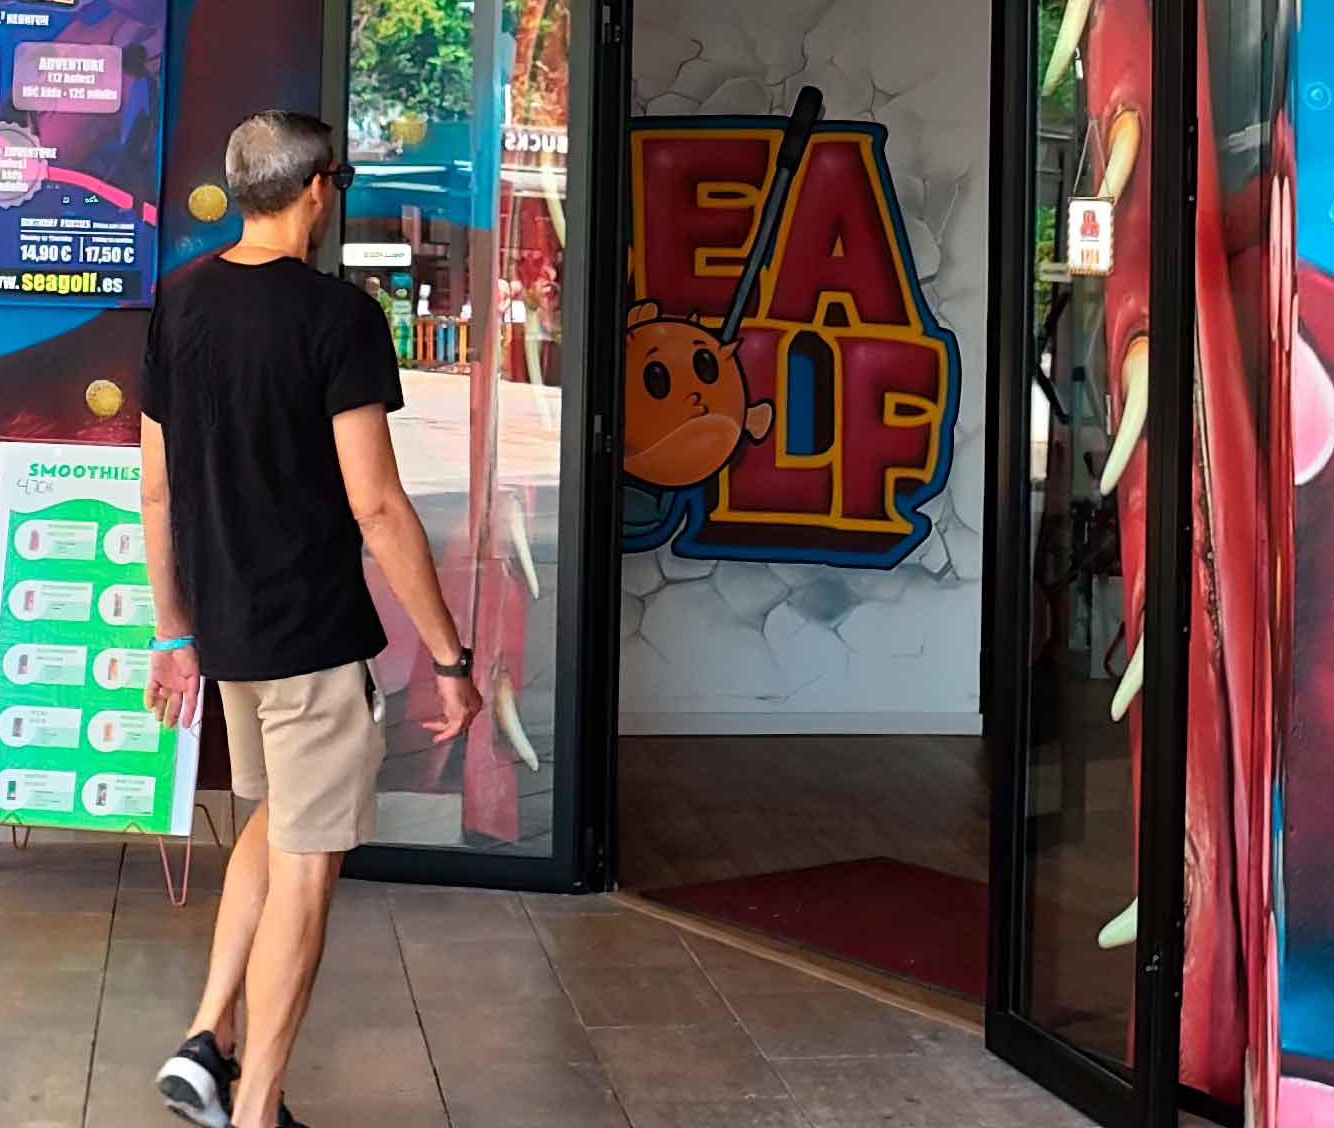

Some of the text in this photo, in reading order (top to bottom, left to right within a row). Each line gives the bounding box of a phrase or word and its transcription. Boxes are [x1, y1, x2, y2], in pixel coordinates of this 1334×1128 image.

[38, 57, 105, 72] ADVENTURE
[629, 129, 918, 330] EA
[20, 245, 72, 262] 14,90 €
[85, 246, 135, 264] 17,50 €
[28, 463, 140, 480] SMOOTHIES
